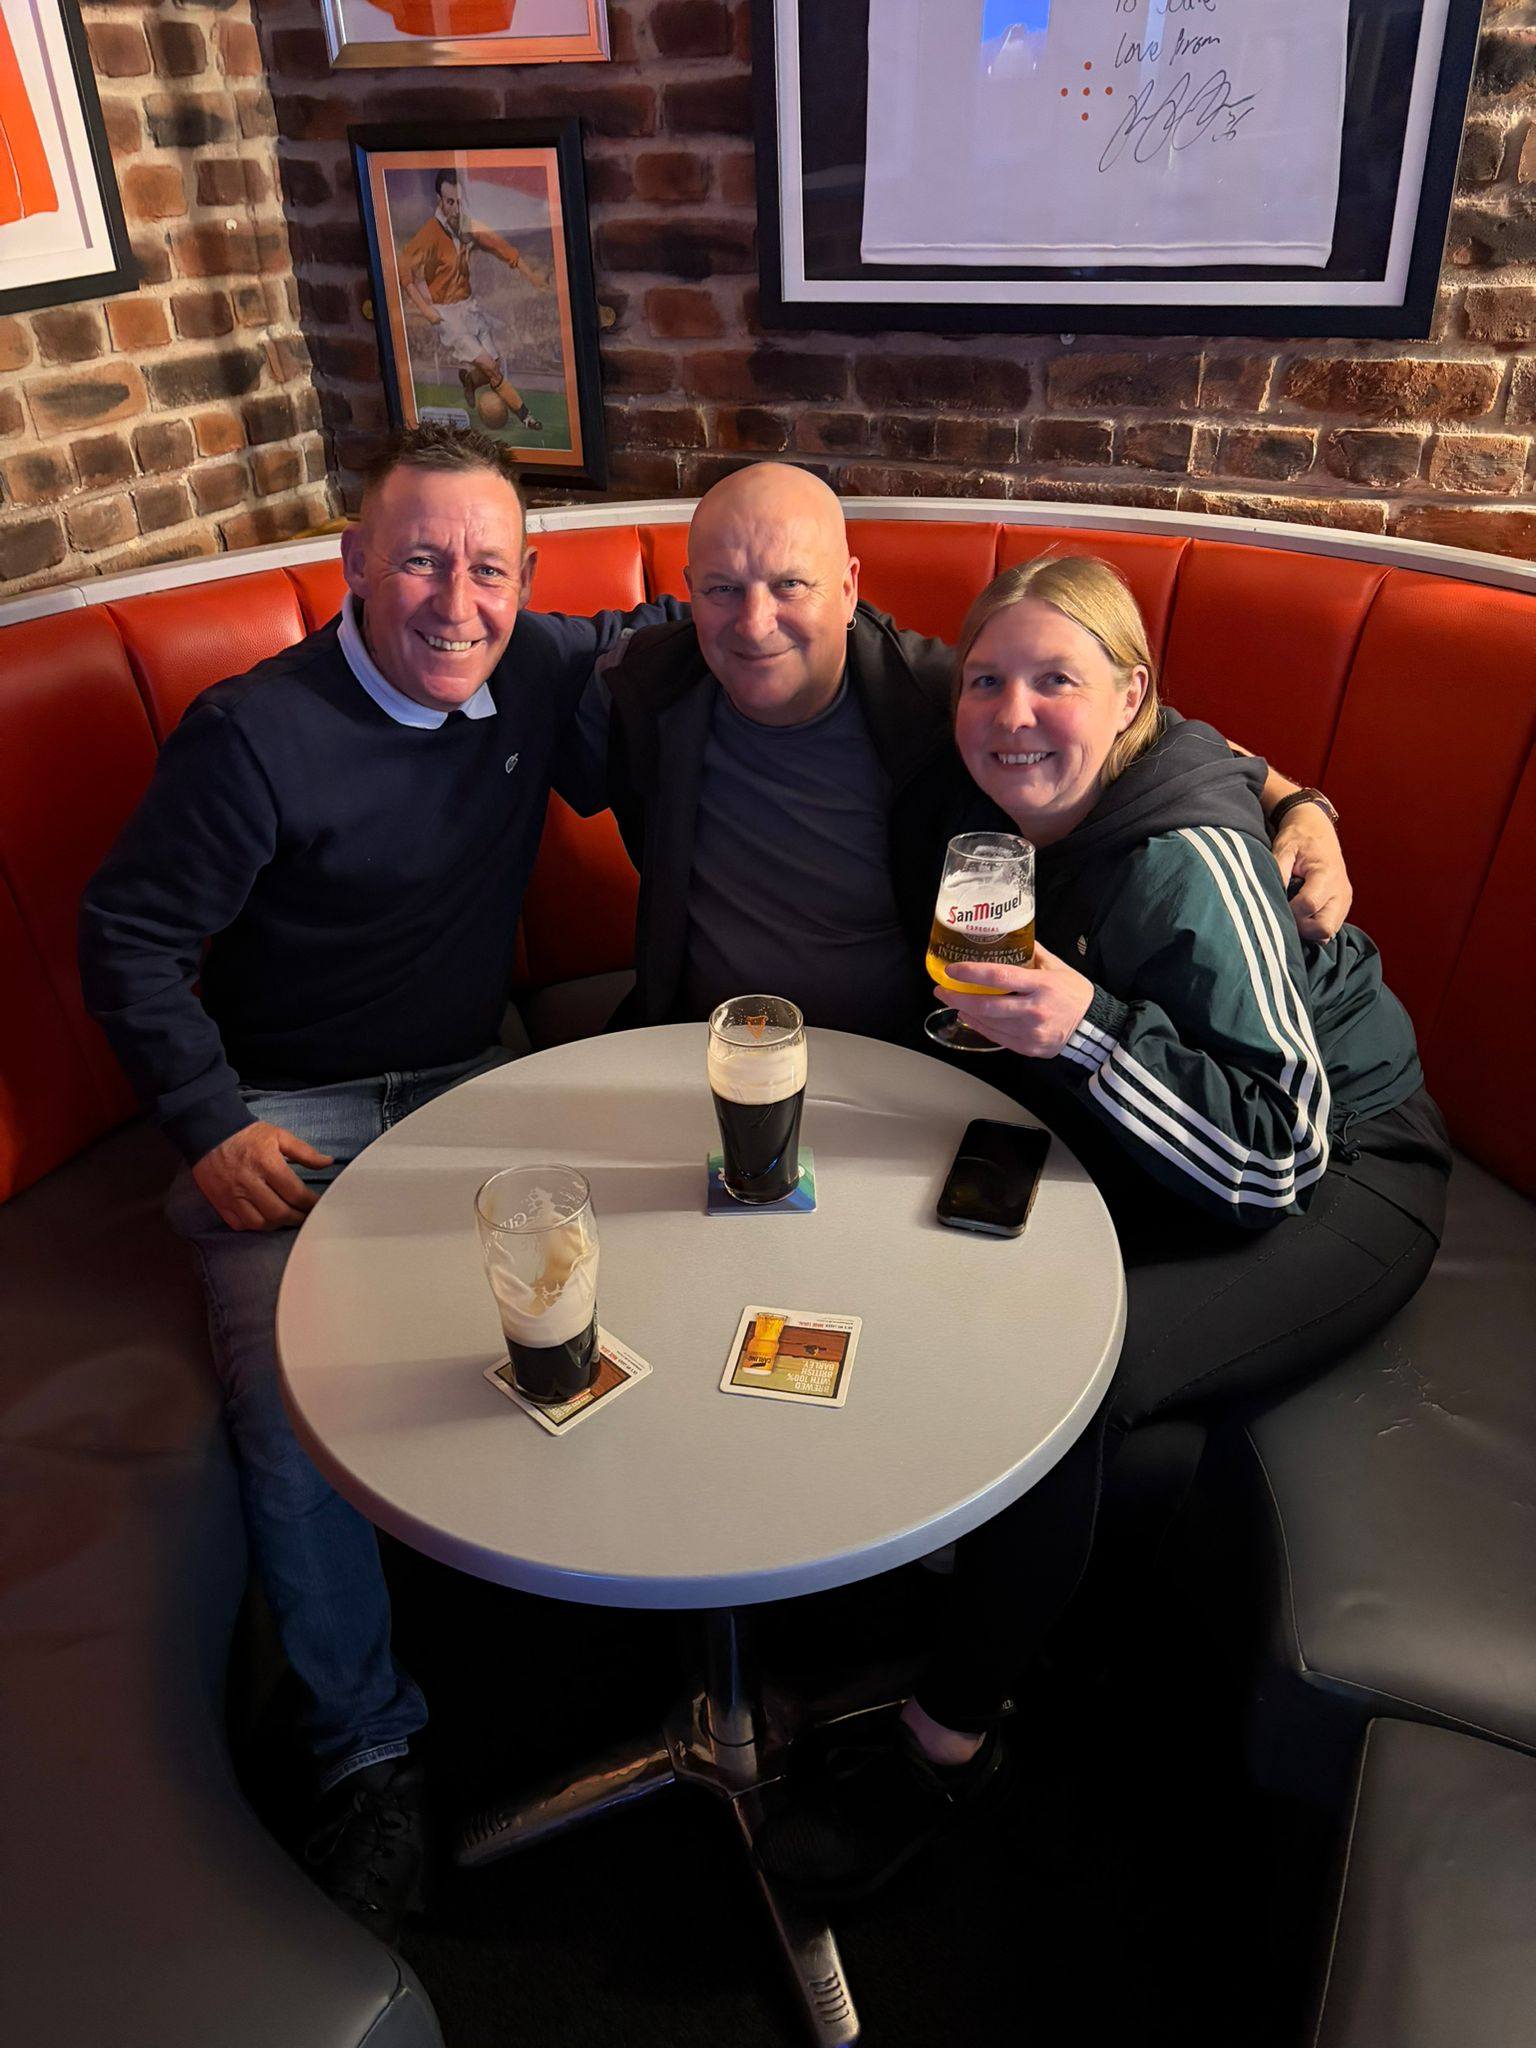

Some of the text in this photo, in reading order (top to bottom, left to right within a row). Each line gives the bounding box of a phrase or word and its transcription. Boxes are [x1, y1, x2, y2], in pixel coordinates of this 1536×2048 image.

[801, 1368, 833, 1378] BRITISH
[786, 1373, 831, 1385] WITH 100%
[795, 1381, 830, 1392] BREWED
